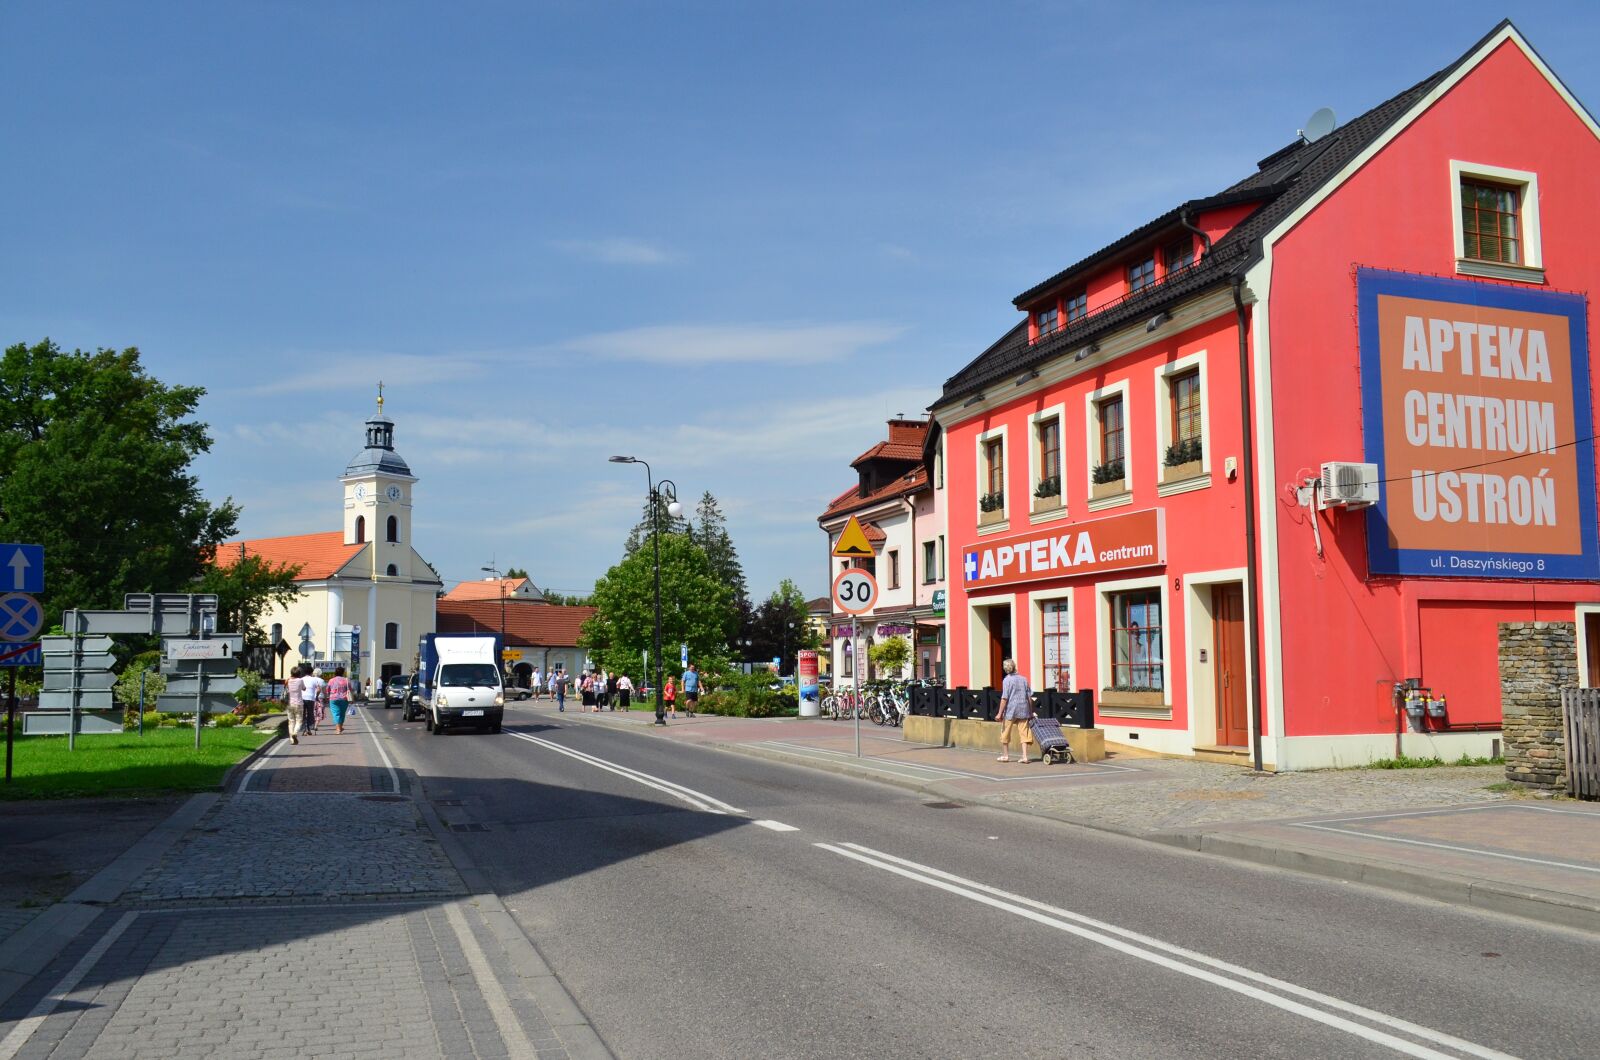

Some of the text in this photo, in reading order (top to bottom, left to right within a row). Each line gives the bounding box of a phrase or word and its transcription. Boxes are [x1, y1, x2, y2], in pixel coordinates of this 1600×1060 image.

[1402, 315, 1552, 383] APTEKA
[1404, 389, 1556, 455] CENTRUM
[1411, 468, 1557, 527] USTROŃ
[979, 530, 1153, 580] APTEKA centrum
[1430, 556, 1545, 573] ul. Daszyńskiego 8
[839, 580, 871, 603] 30
[1174, 577, 1181, 591] 8
